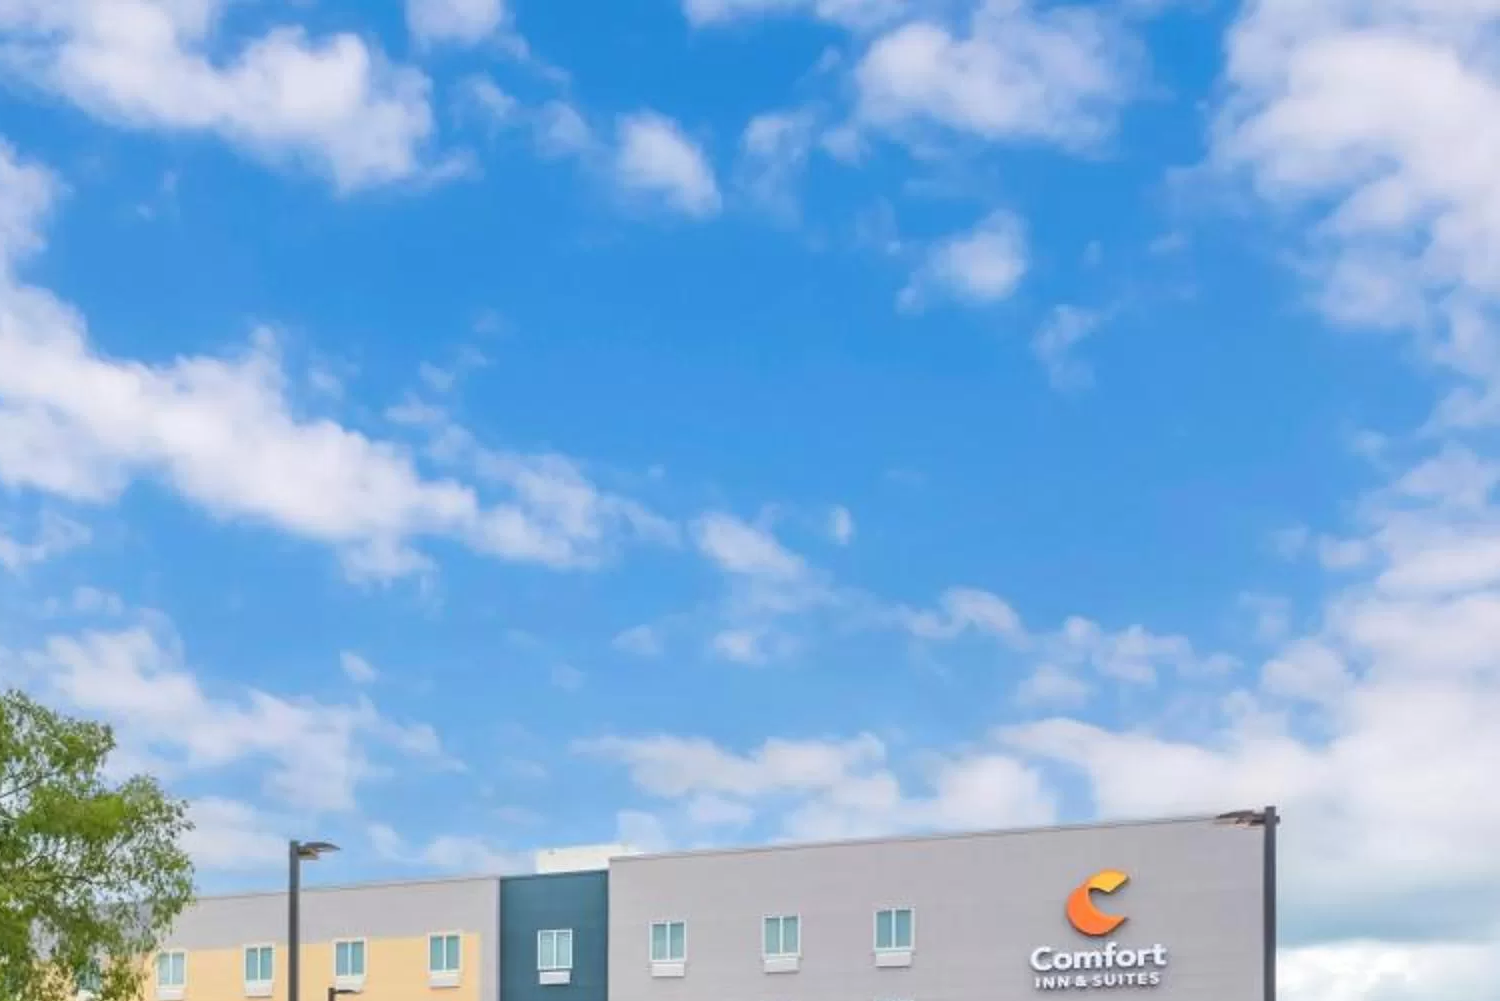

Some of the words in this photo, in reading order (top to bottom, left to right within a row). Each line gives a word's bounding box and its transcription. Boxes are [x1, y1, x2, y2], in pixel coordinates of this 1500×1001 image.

[1030, 941, 1167, 971] Comfort
[1035, 975, 1069, 989] INN
[1075, 975, 1087, 988] &
[1092, 971, 1160, 987] SUITES
